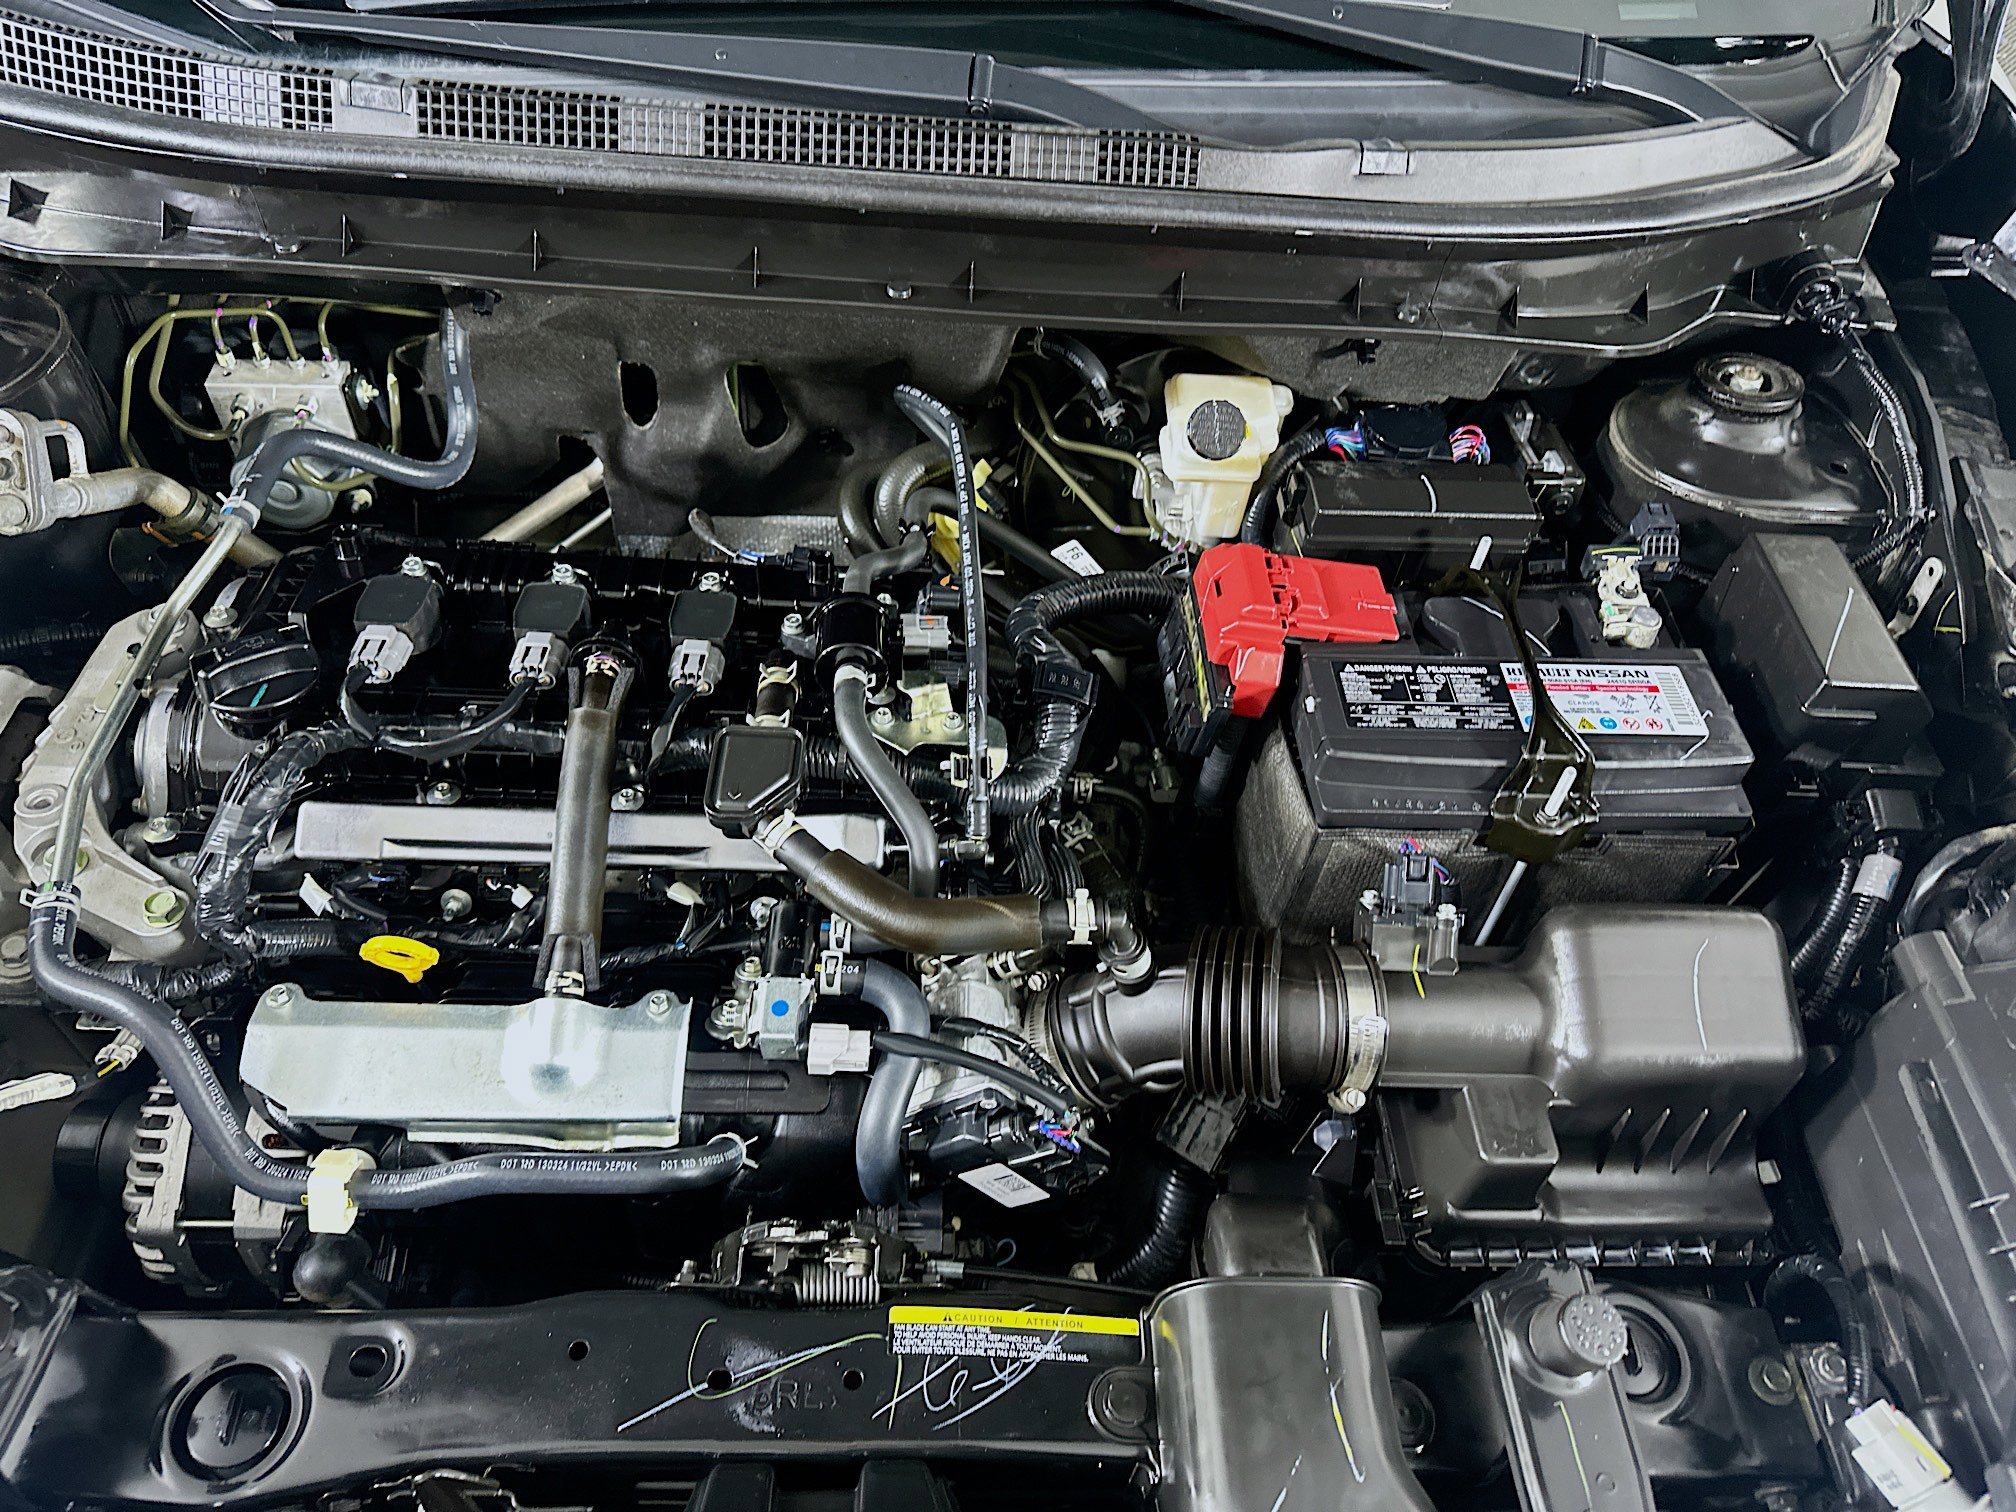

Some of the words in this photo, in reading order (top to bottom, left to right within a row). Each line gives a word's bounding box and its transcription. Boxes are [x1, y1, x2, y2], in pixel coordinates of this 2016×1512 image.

[1355, 664, 1413, 673] DANGER/POISON
[1427, 665, 1488, 675] PELIGRO/VENENO
[1576, 669, 1650, 678] NISSAN
[170, 1017, 186, 1035] DOT
[191, 1049, 210, 1079] 130324
[244, 1147, 259, 1162] DOT
[501, 1158, 518, 1169] DOT
[538, 1159, 568, 1171] 130324
[661, 1159, 678, 1171] DOT
[371, 1173, 388, 1185] DOT
[954, 1313, 1003, 1323] CAUTION
[1026, 1317, 1083, 1329] ATTENTION
[894, 1323, 906, 1331] FAN
[906, 1323, 925, 1332] BLADE
[925, 1324, 938, 1332] CAN
[939, 1324, 957, 1332] START
[957, 1324, 964, 1332] AT
[894, 1331, 902, 1339] TO
[902, 1331, 918, 1339] HELP
[918, 1331, 936, 1339] AVOID
[937, 1331, 966, 1340] PERSONAL
[987, 1333, 1001, 1341] KEEP
[1002, 1334, 1022, 1342] HANDS
[893, 1338, 901, 1346] LE
[901, 1339, 942, 1347] VENTILATEUR
[943, 1339, 966, 1348] RISQUE
[967, 1340, 975, 1348] DE
[1016, 1342, 1032, 1351] TOUT
[893, 1346, 911, 1354] POUR
[933, 1347, 954, 1355] TOUTE
[987, 1348, 996, 1357] NE
[996, 1349, 1008, 1357] PAS
[1009, 1350, 1018, 1358] EN
[1056, 1352, 1066, 1361] LES
